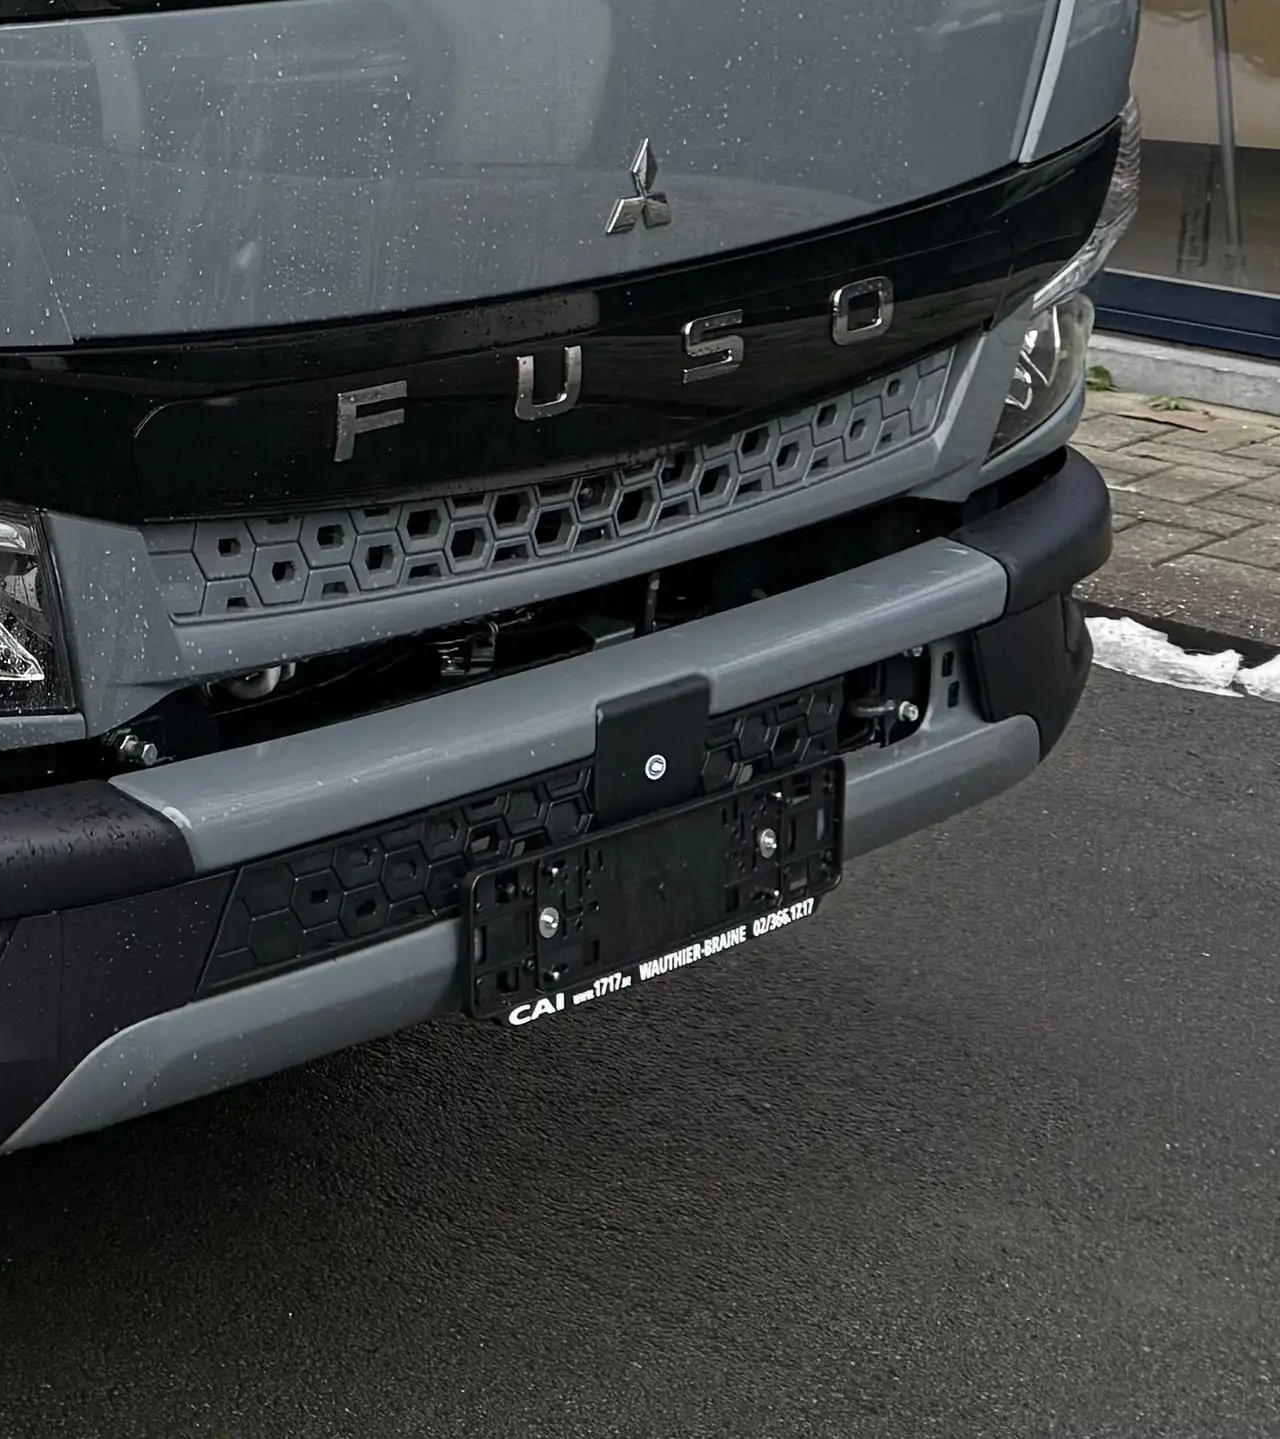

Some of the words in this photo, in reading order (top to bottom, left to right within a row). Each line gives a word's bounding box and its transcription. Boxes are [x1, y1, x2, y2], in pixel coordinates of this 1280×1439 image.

[333, 275, 894, 463] FUSO
[508, 992, 565, 1026] CAI
[638, 924, 748, 981] WAUTHIER-BRAINE
